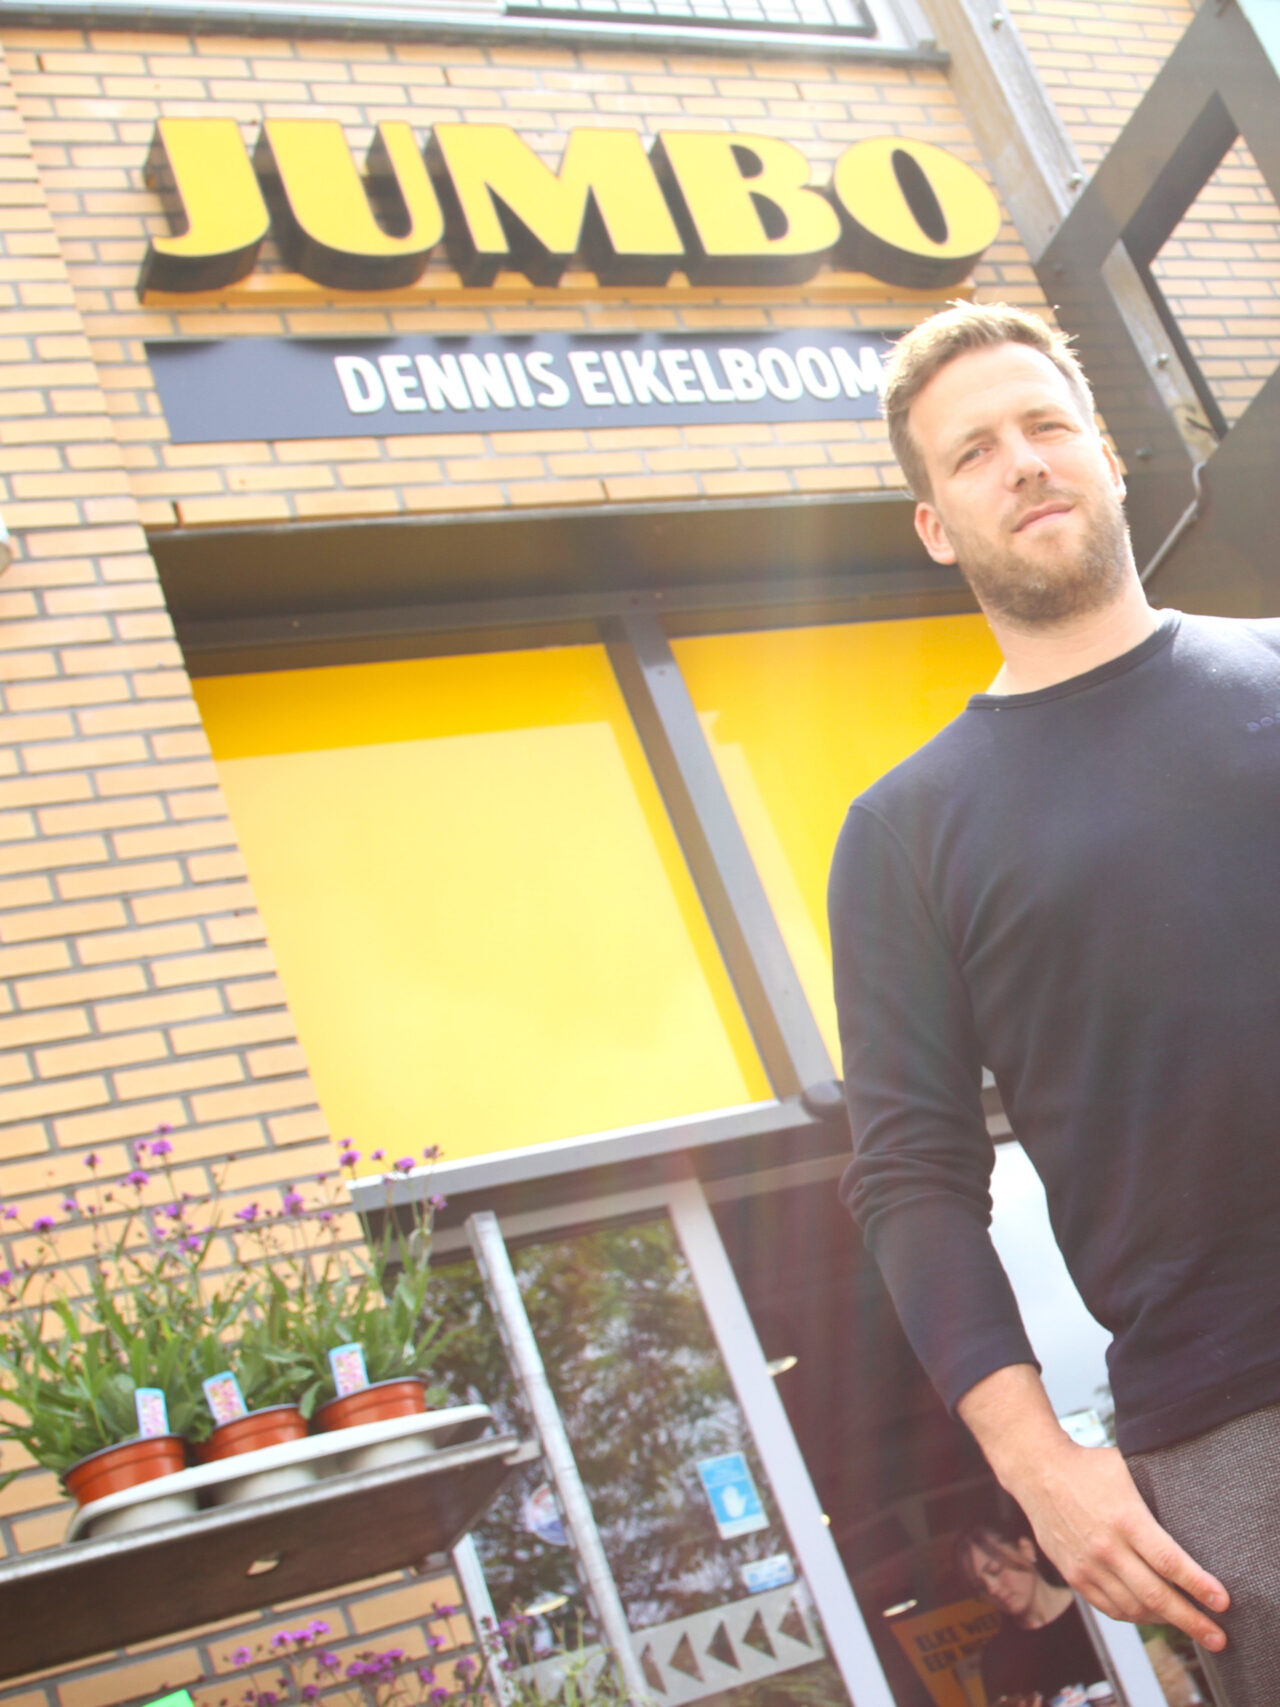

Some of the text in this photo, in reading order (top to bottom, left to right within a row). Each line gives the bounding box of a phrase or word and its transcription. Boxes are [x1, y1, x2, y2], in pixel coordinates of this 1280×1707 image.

[152, 114, 1002, 262] JUMBO
[334, 346, 885, 414] DENNIS EIKELBOOM
